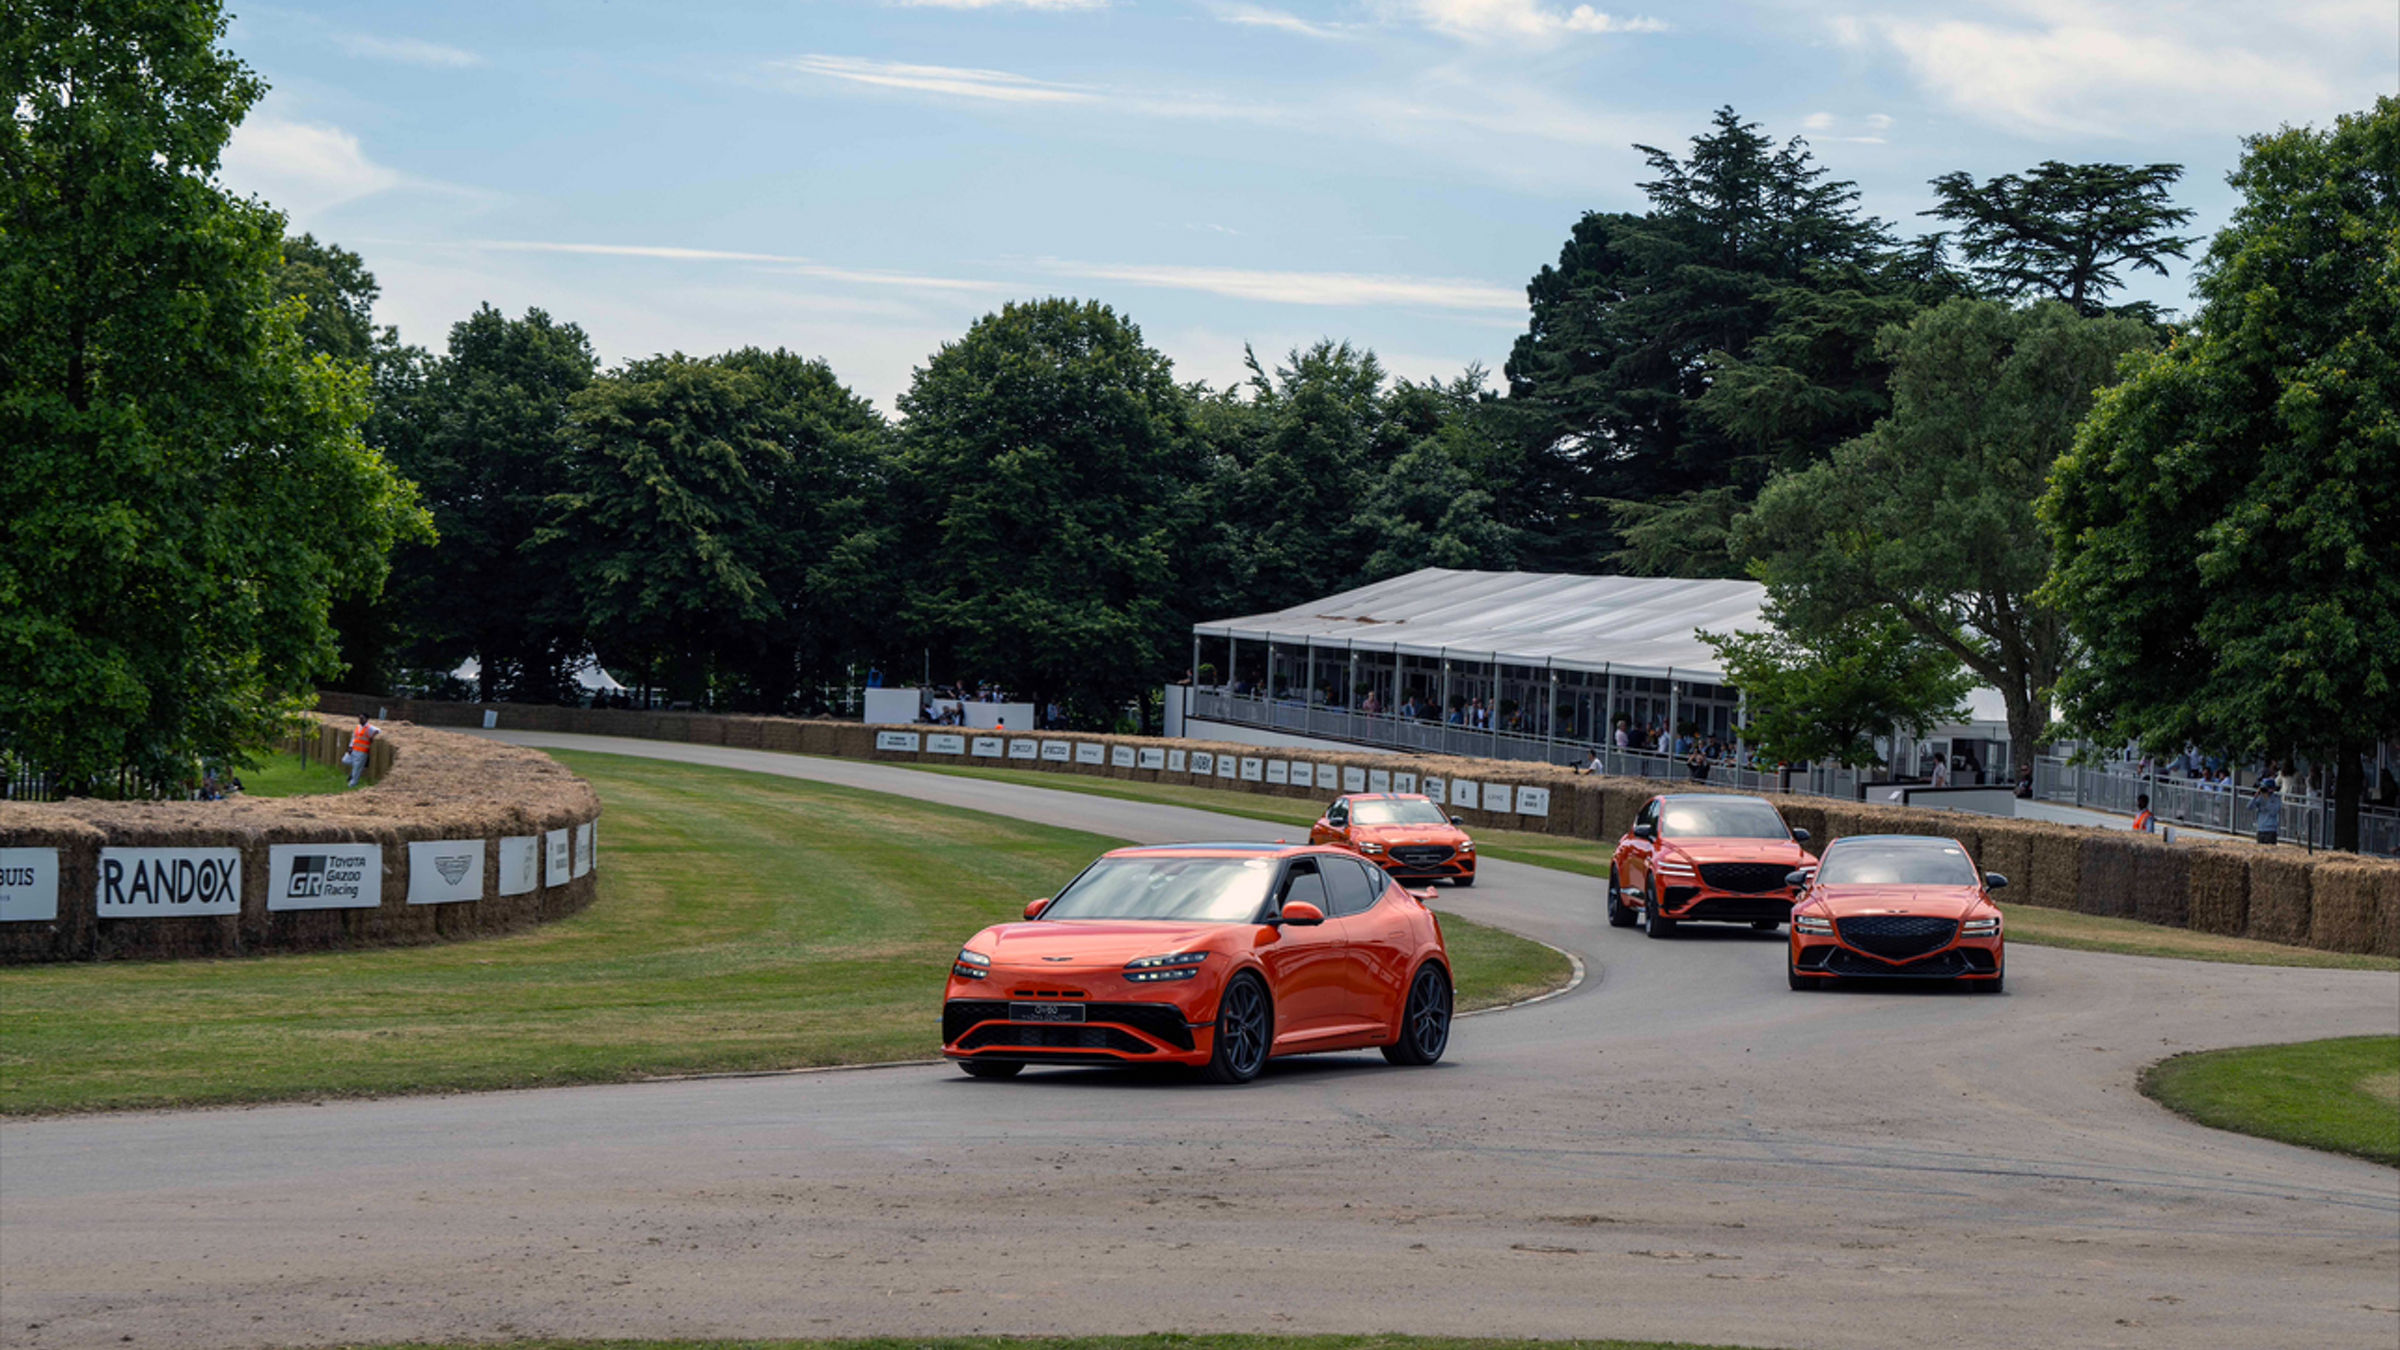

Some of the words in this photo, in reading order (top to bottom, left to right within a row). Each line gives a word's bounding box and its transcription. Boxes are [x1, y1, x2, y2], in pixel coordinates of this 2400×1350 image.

[330, 856, 366, 868] TOYOTA
[104, 857, 237, 905] RANDOX
[288, 872, 323, 896] GR
[326, 870, 361, 882] GAZOO
[324, 883, 359, 899] Racing
